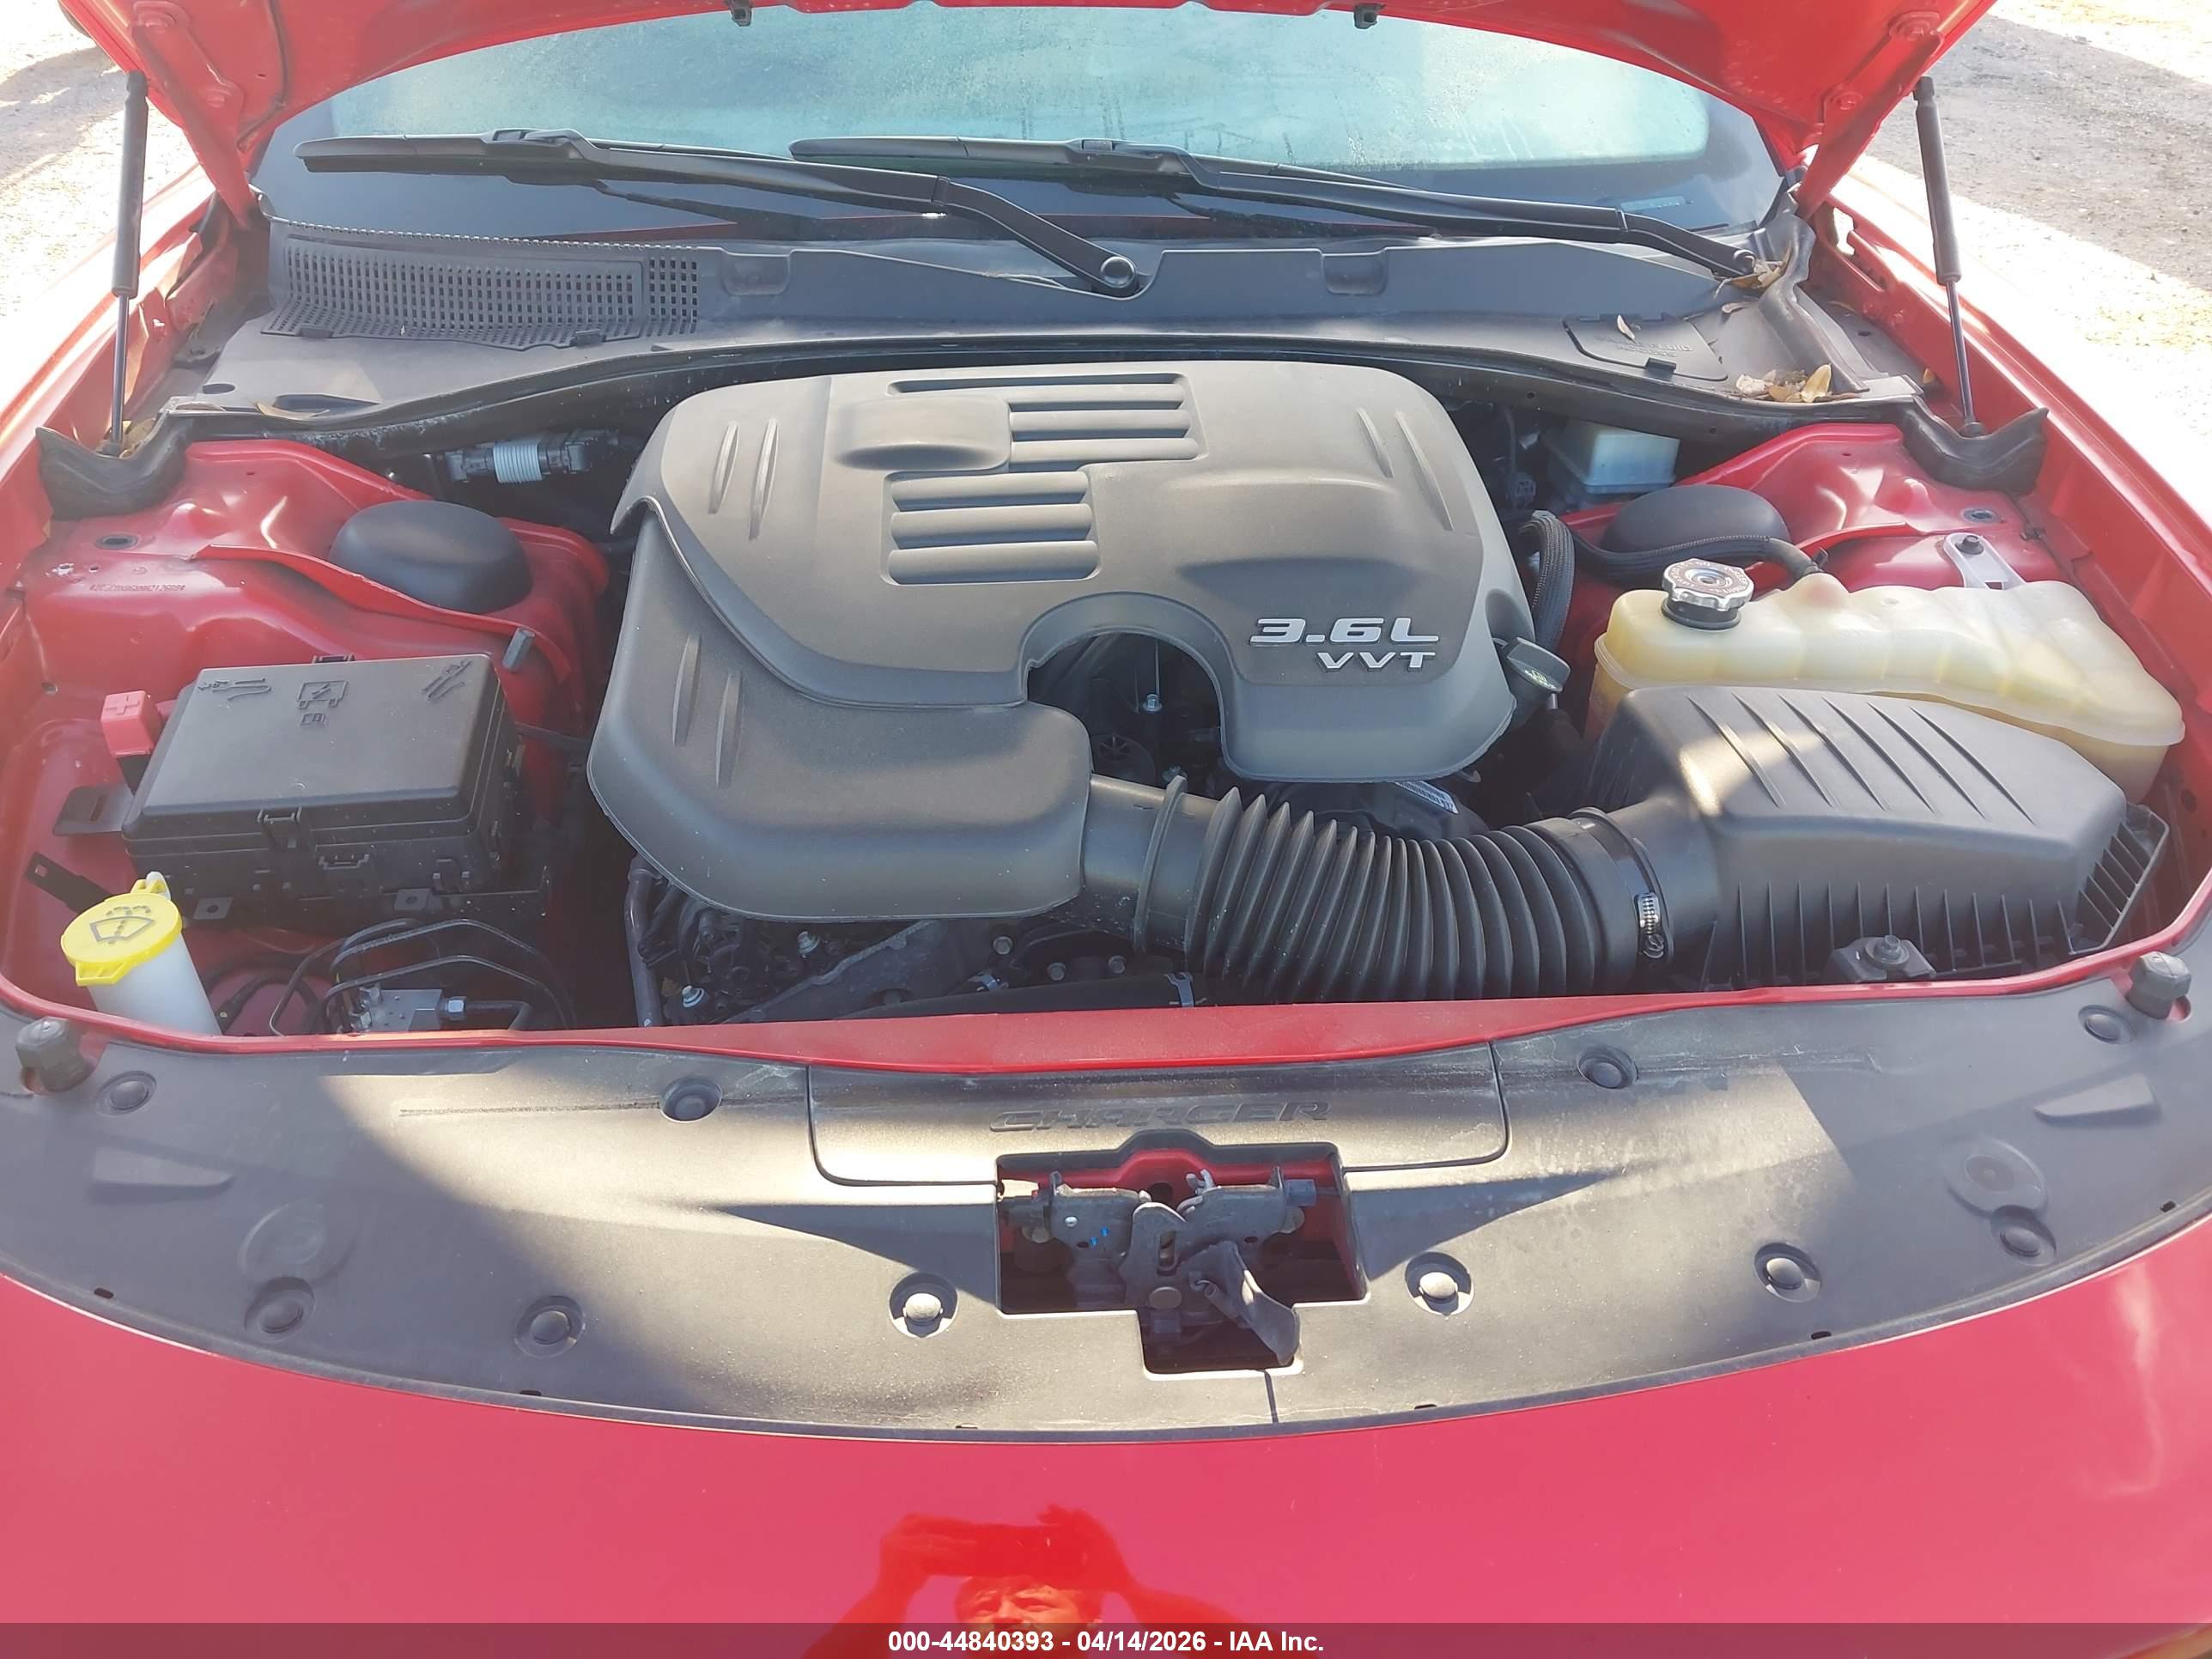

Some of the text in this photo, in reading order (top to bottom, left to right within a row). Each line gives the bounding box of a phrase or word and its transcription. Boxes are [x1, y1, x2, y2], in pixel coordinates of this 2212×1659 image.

[1250, 617, 1439, 643] 3.6L
[1316, 651, 1436, 672] VVT
[989, 1101, 1331, 1132] CHARGER
